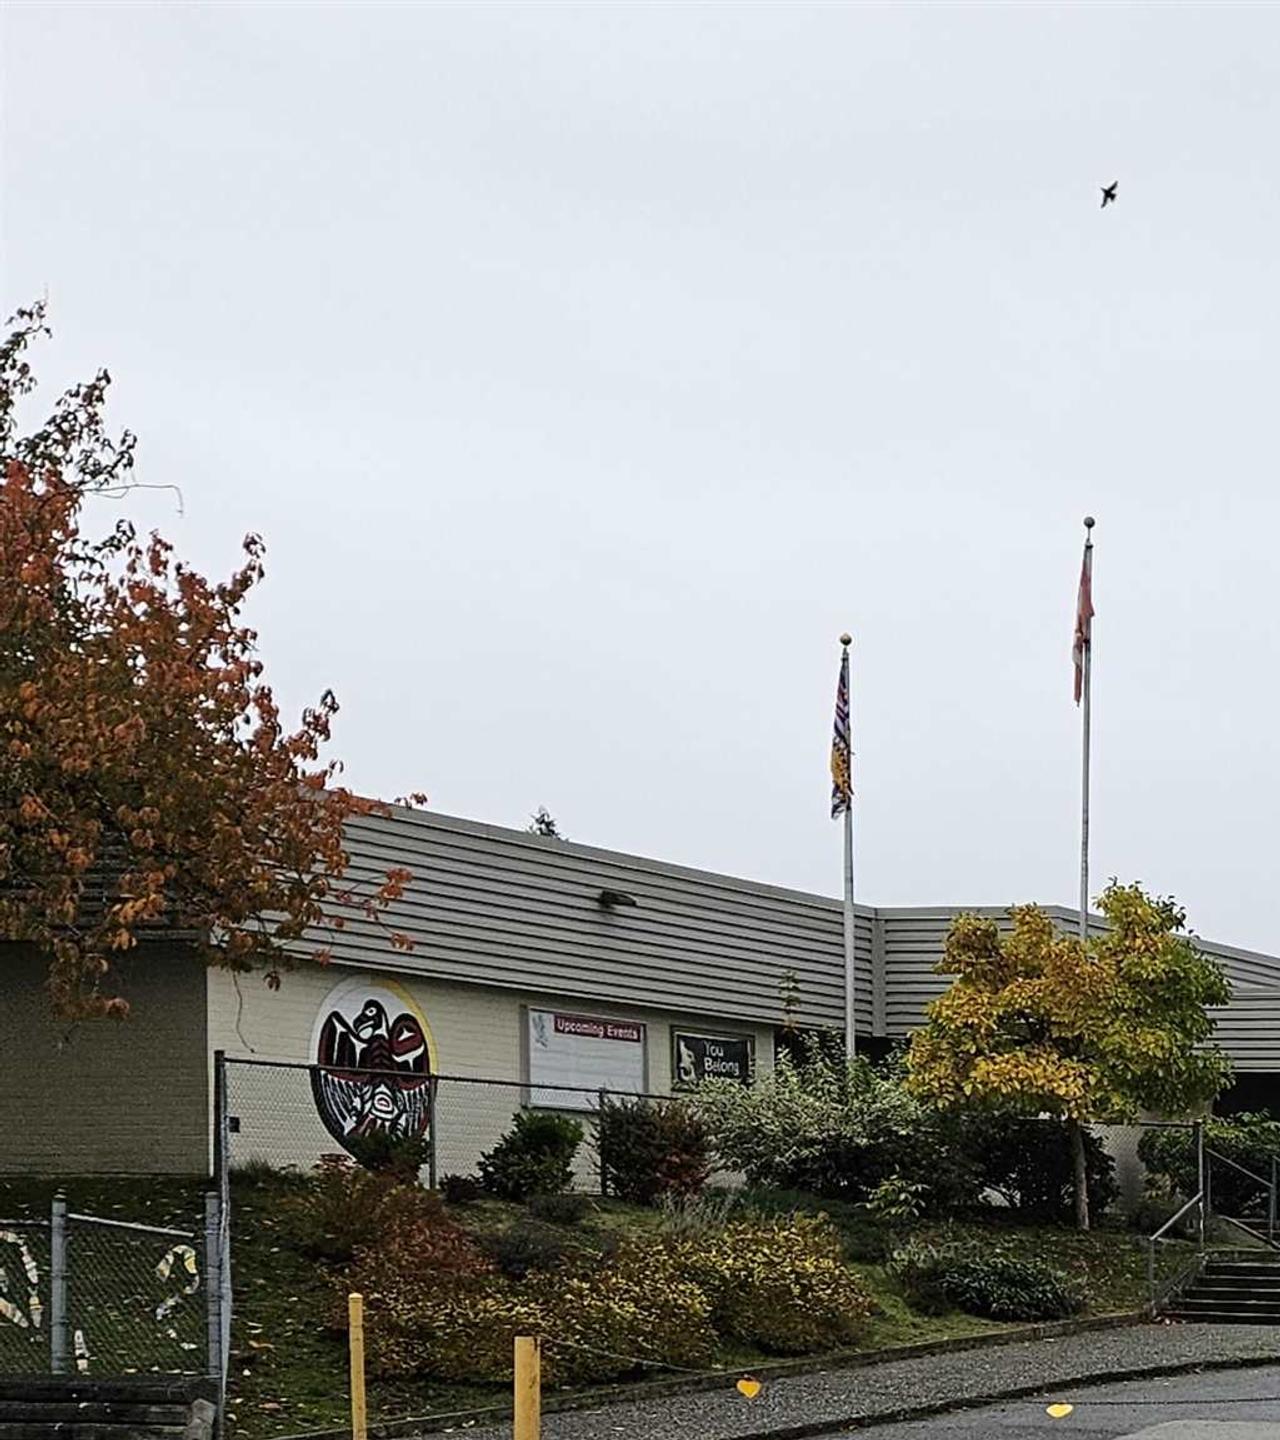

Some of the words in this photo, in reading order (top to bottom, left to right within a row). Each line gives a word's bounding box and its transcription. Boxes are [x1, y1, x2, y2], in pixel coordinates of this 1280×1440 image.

[557, 1018, 605, 1038] Upcoming
[607, 1025, 639, 1040] Events
[703, 1040, 724, 1057] You
[703, 1057, 740, 1076] Belong
